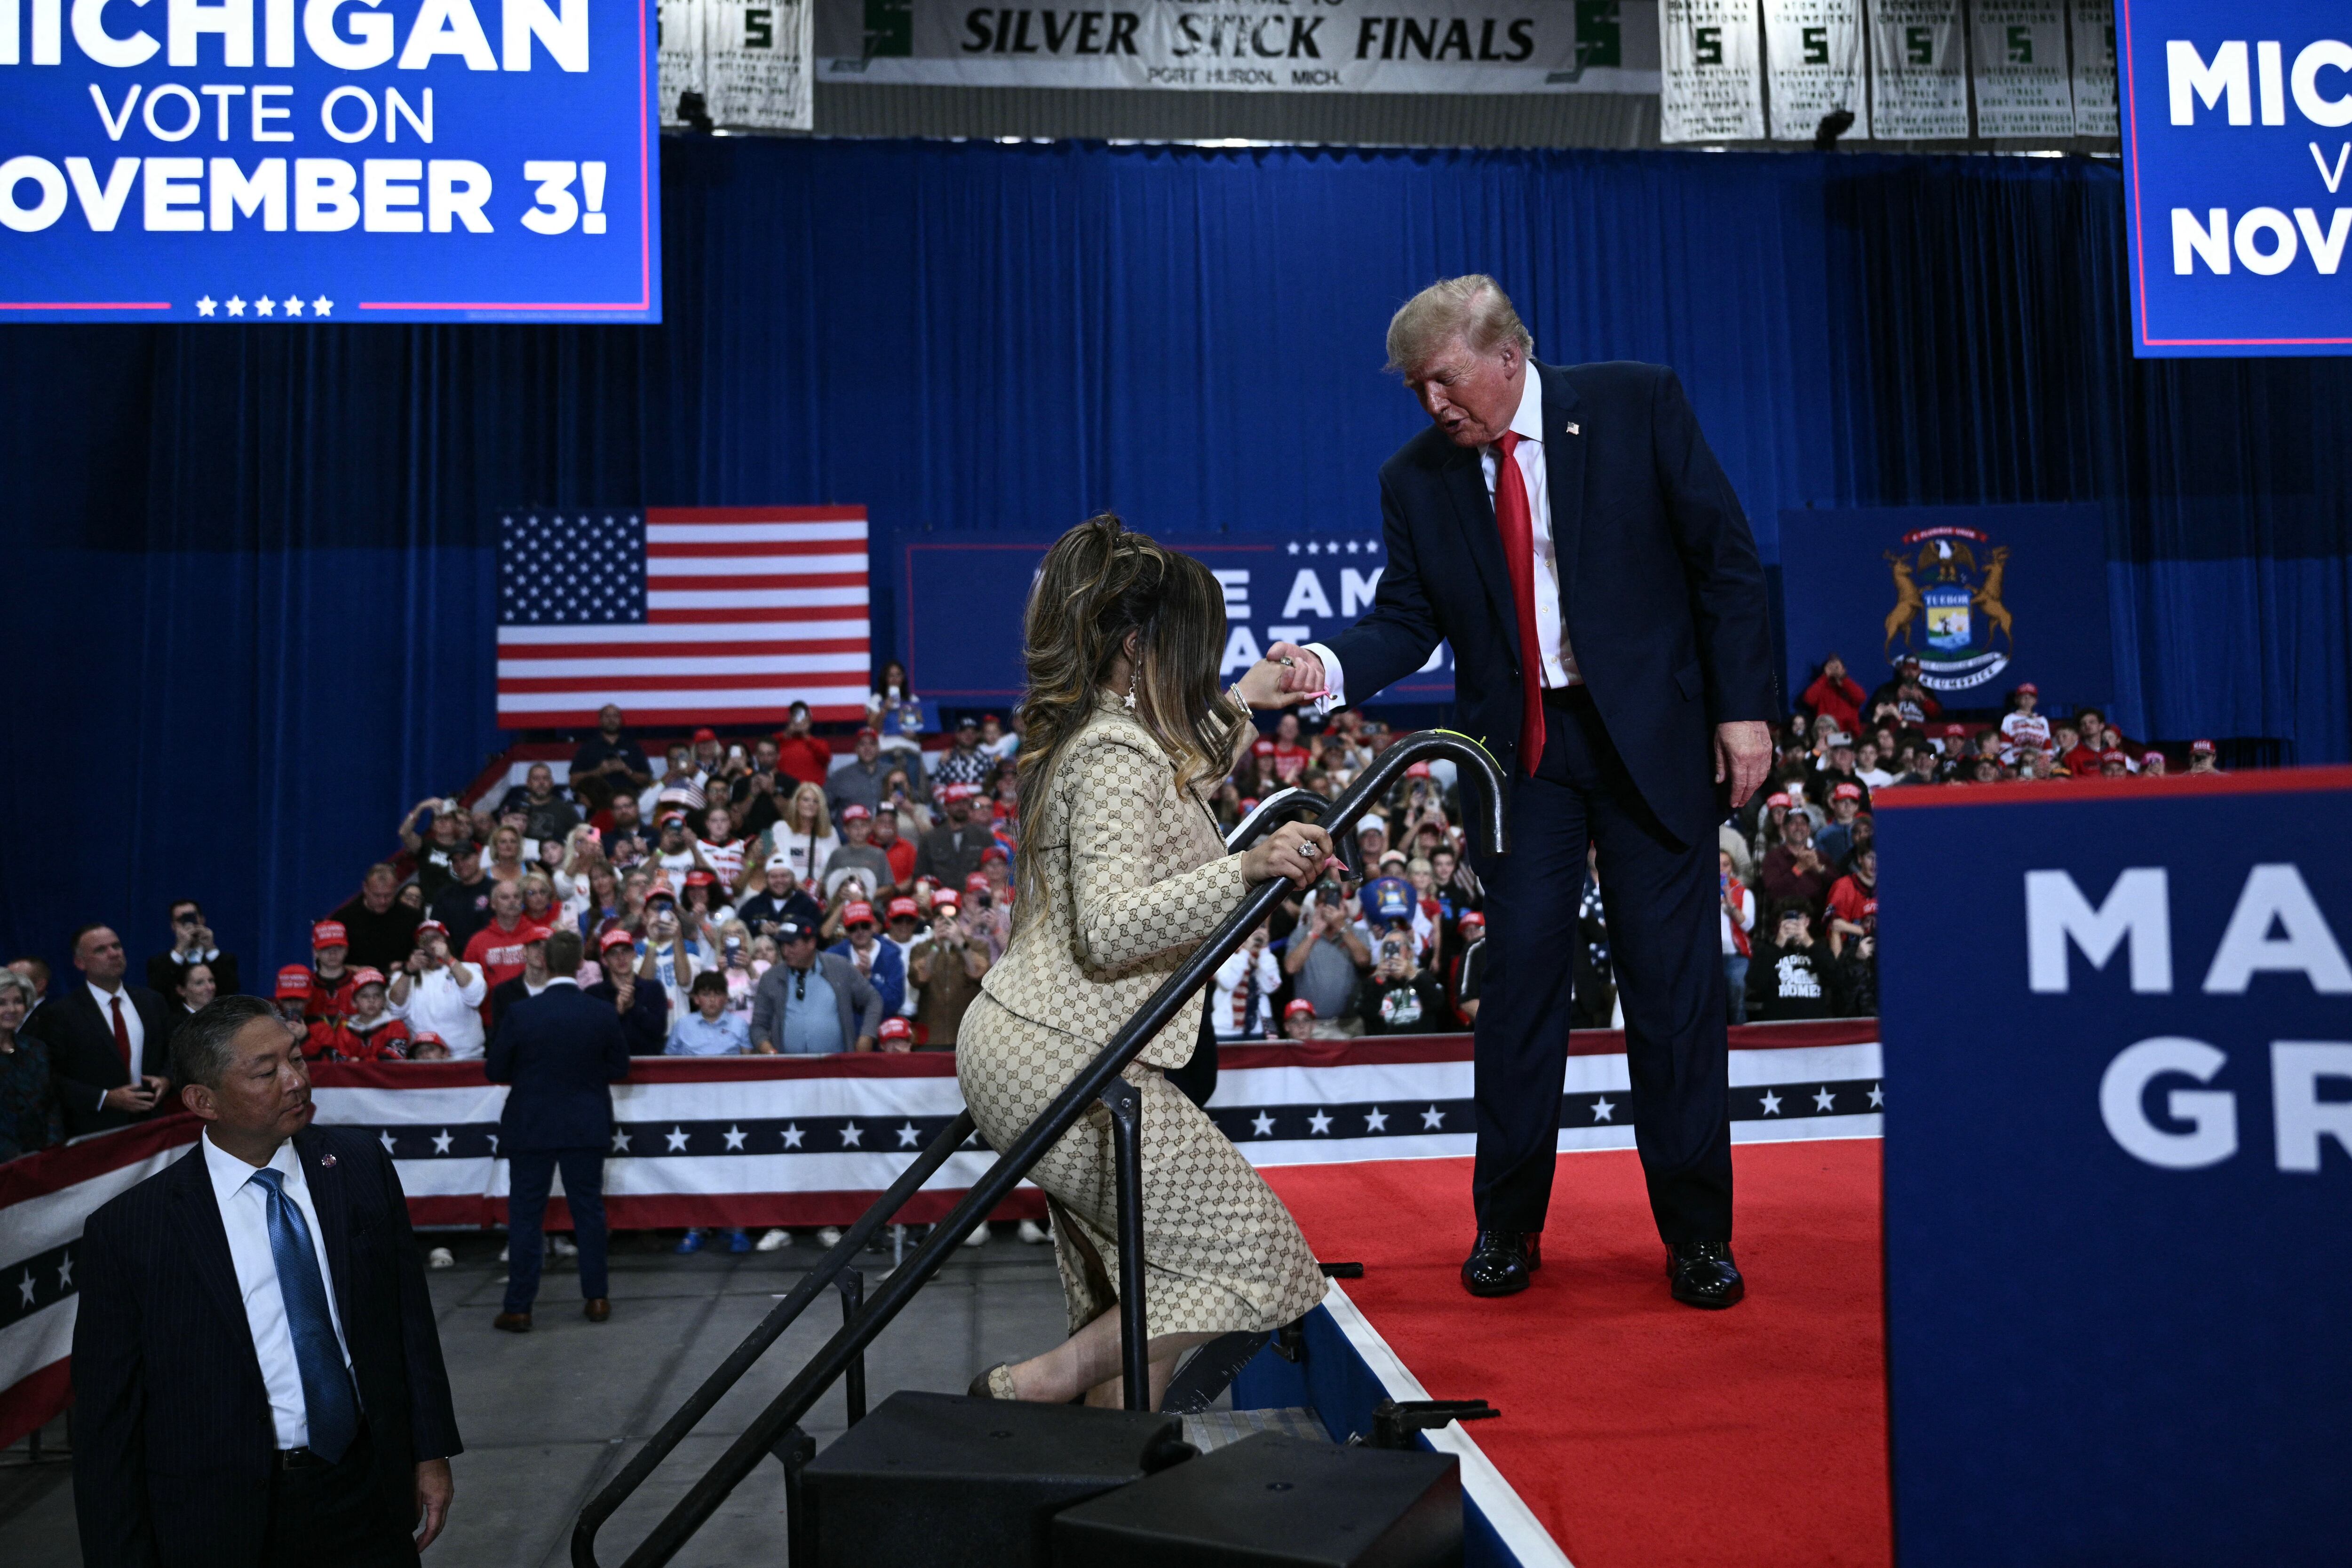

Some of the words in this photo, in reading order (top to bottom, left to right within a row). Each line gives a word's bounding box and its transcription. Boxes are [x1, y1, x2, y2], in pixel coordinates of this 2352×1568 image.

[0, 0, 589, 72] ICHIGAN
[961, 7, 1141, 56] SILVER
[1171, 13, 1325, 59] STICK
[1355, 17, 1535, 62] FINALS
[1147, 67, 1198, 84] PORT
[2166, 39, 2352, 127] MIC
[89, 84, 294, 142] VOTE
[321, 86, 433, 143] ON
[520, 160, 607, 235] 3!
[2171, 206, 2352, 276] NOV
[2024, 863, 2352, 994] MA
[2099, 1036, 2352, 1173] GR
